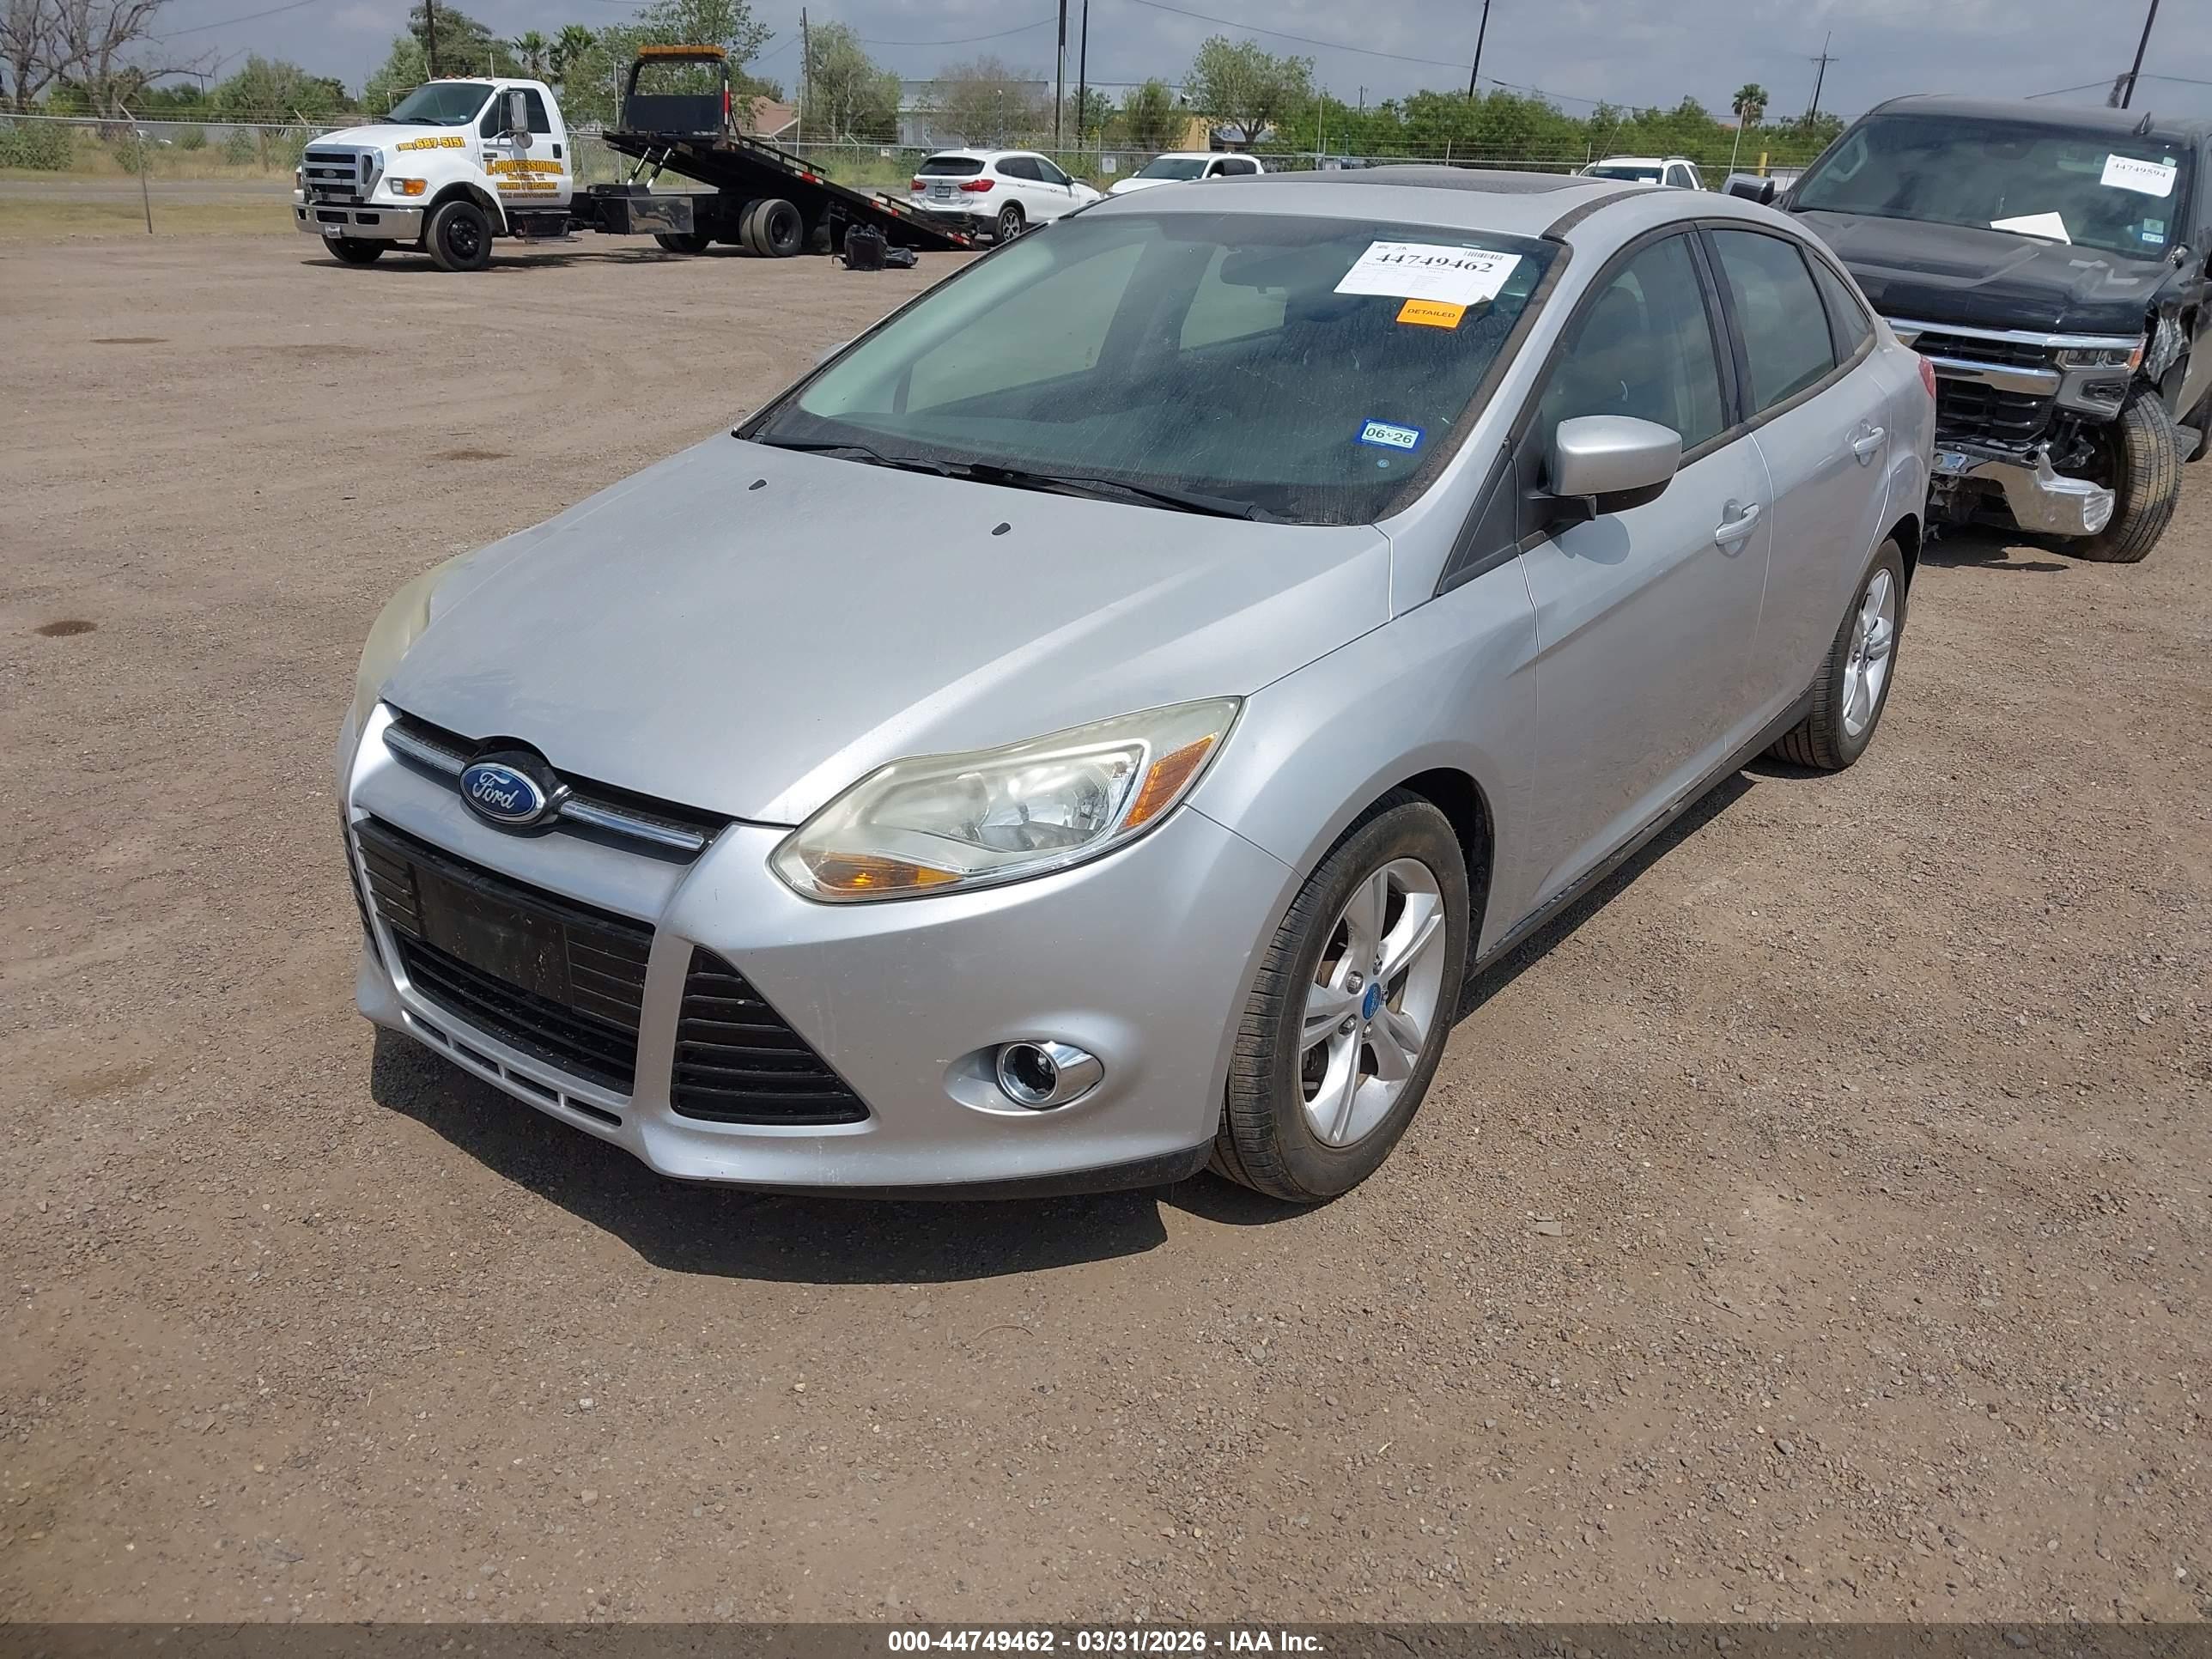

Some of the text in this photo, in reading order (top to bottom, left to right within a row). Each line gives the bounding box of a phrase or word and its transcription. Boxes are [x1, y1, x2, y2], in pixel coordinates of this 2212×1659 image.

[1376, 253, 1494, 273] 44749462
[1407, 308, 1456, 319] DETAILED
[472, 771, 520, 810] Ford
